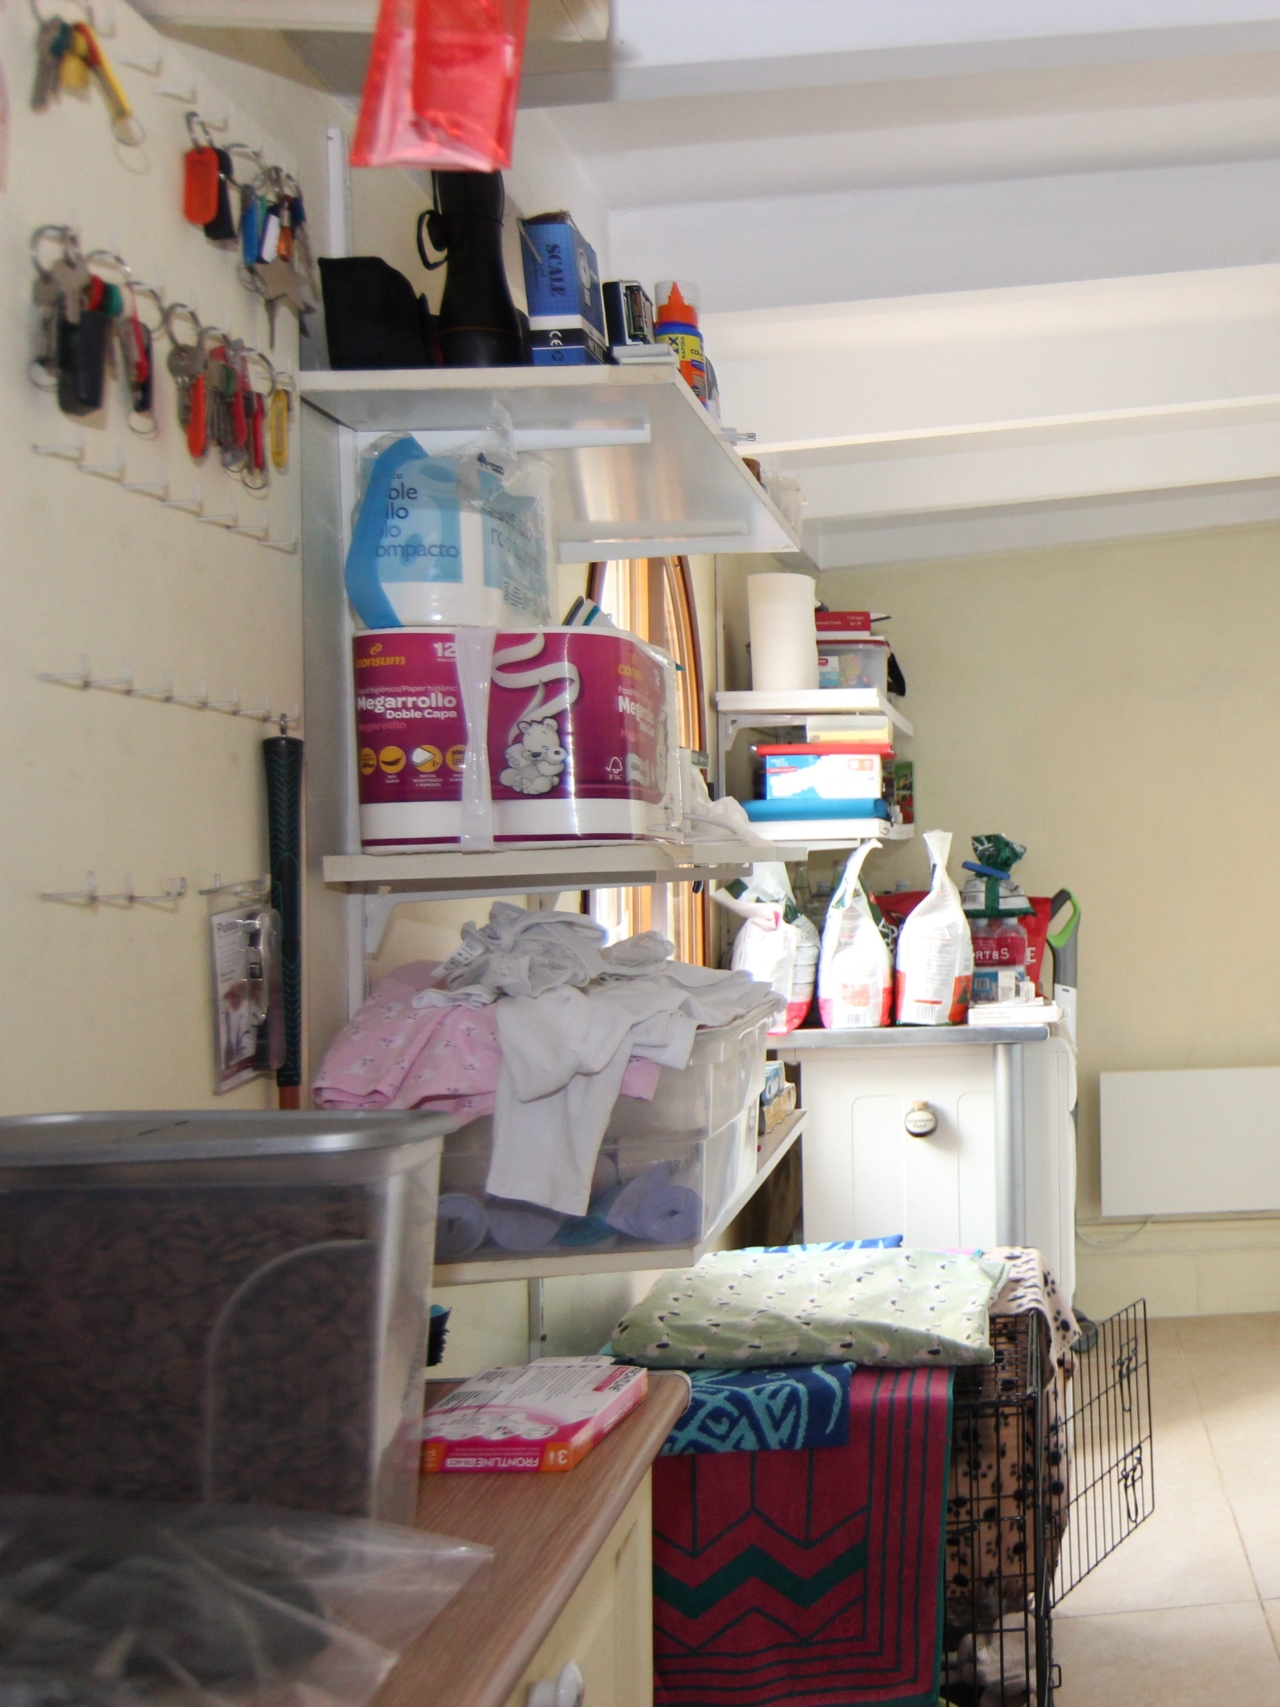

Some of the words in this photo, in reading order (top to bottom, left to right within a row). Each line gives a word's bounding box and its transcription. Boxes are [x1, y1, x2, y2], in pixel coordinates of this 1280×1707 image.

[545, 243, 566, 298] SCALE
[386, 502, 409, 519] llo
[376, 543, 460, 562] ompacto
[434, 642, 456, 657] 12
[356, 656, 406, 668] consum
[357, 692, 457, 713] Megarrollo
[386, 709, 423, 719] Doble
[424, 708, 458, 720] Capa
[476, 1457, 539, 1467] FRONTLINE
[559, 1449, 568, 1465] 3
